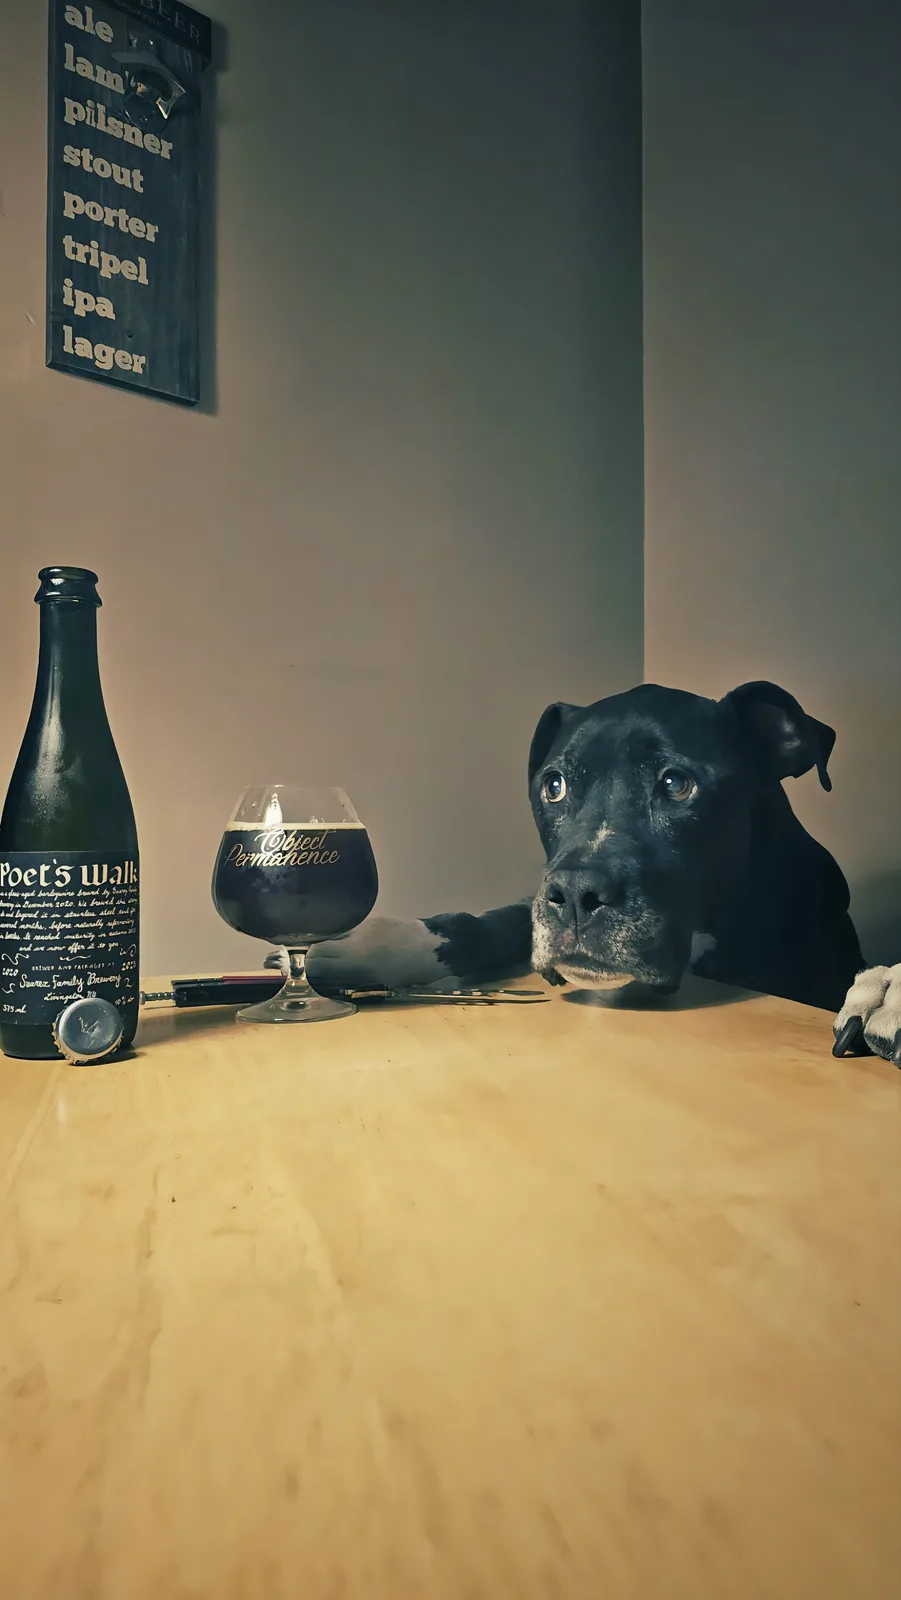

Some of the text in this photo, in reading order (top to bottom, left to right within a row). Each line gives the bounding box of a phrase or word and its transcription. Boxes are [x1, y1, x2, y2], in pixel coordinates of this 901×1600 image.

[64, 4, 114, 43] ale
[64, 42, 128, 95] lam
[64, 96, 173, 160] pilsner
[63, 144, 144, 193] stout
[63, 191, 159, 242] porter
[62, 235, 149, 285] tripel
[62, 278, 116, 320] ipa
[62, 325, 147, 374] lager
[254, 828, 337, 854] Object
[0, 858, 75, 888] Poet's
[19, 971, 122, 993] Suarez Family Brewery
[43, 991, 85, 1004] Livingston
